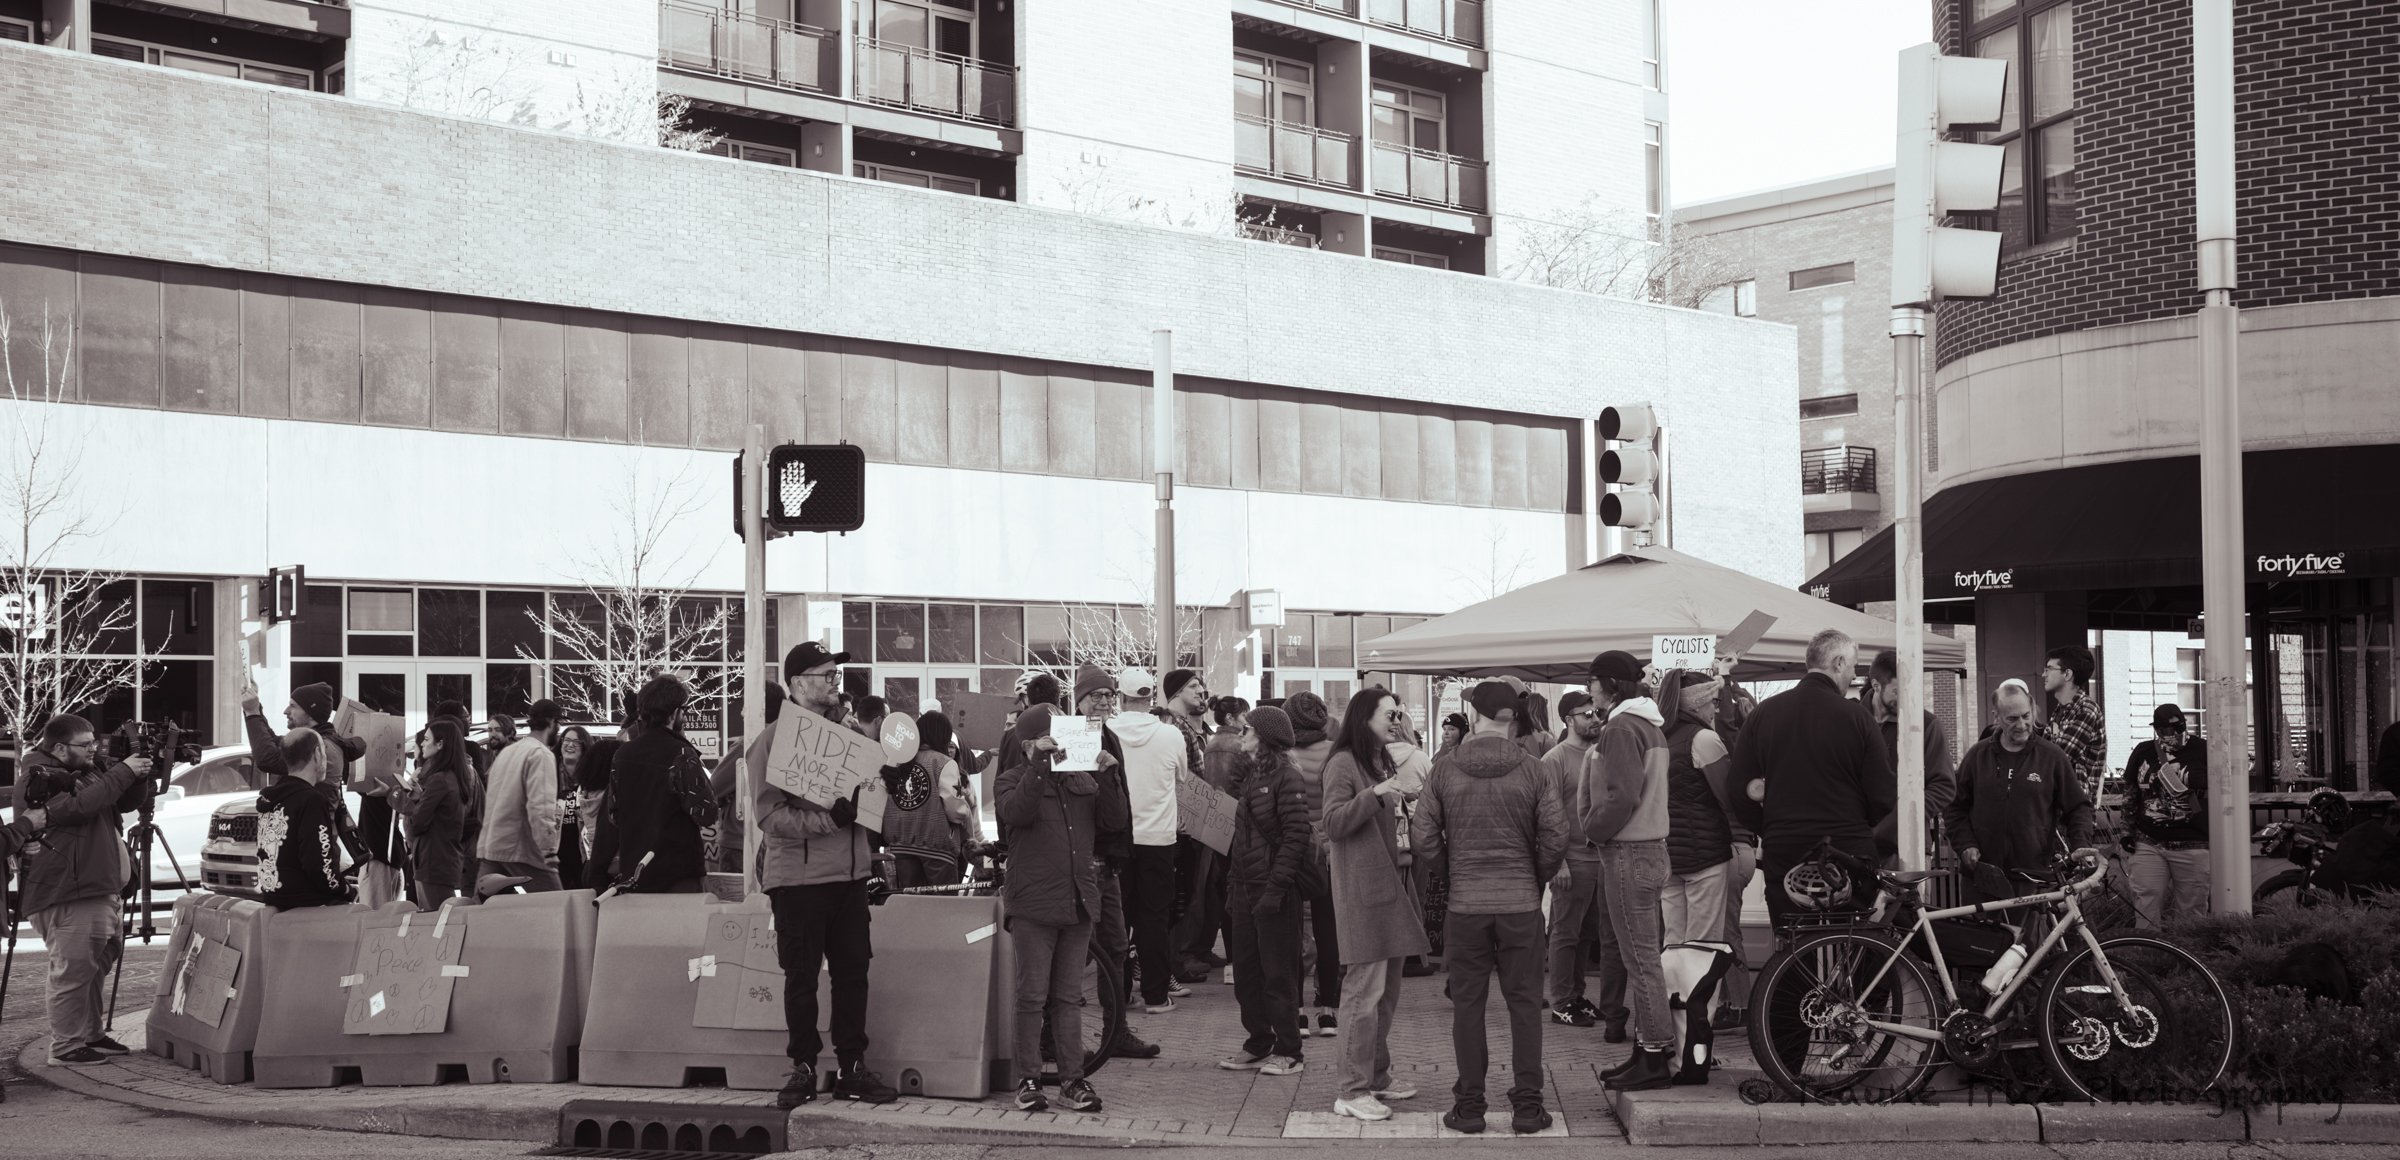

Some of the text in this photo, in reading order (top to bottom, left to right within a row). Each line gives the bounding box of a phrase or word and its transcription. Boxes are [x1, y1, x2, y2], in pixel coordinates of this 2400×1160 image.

[1287, 635, 1302, 646] 747
[1661, 637, 1710, 654] CYCLISTS
[1675, 659, 1689, 668] FOR
[683, 714, 717, 722] AILABLE
[895, 731, 905, 742] TO
[896, 723, 916, 741] ROAD
[690, 737, 717, 747] ALO
[794, 715, 862, 777] RIDE
[884, 733, 902, 749] ZERO
[788, 752, 848, 789] MORE
[780, 769, 844, 800] BIKES
[218, 823, 231, 831] KIA
[376, 948, 423, 977] Peace
